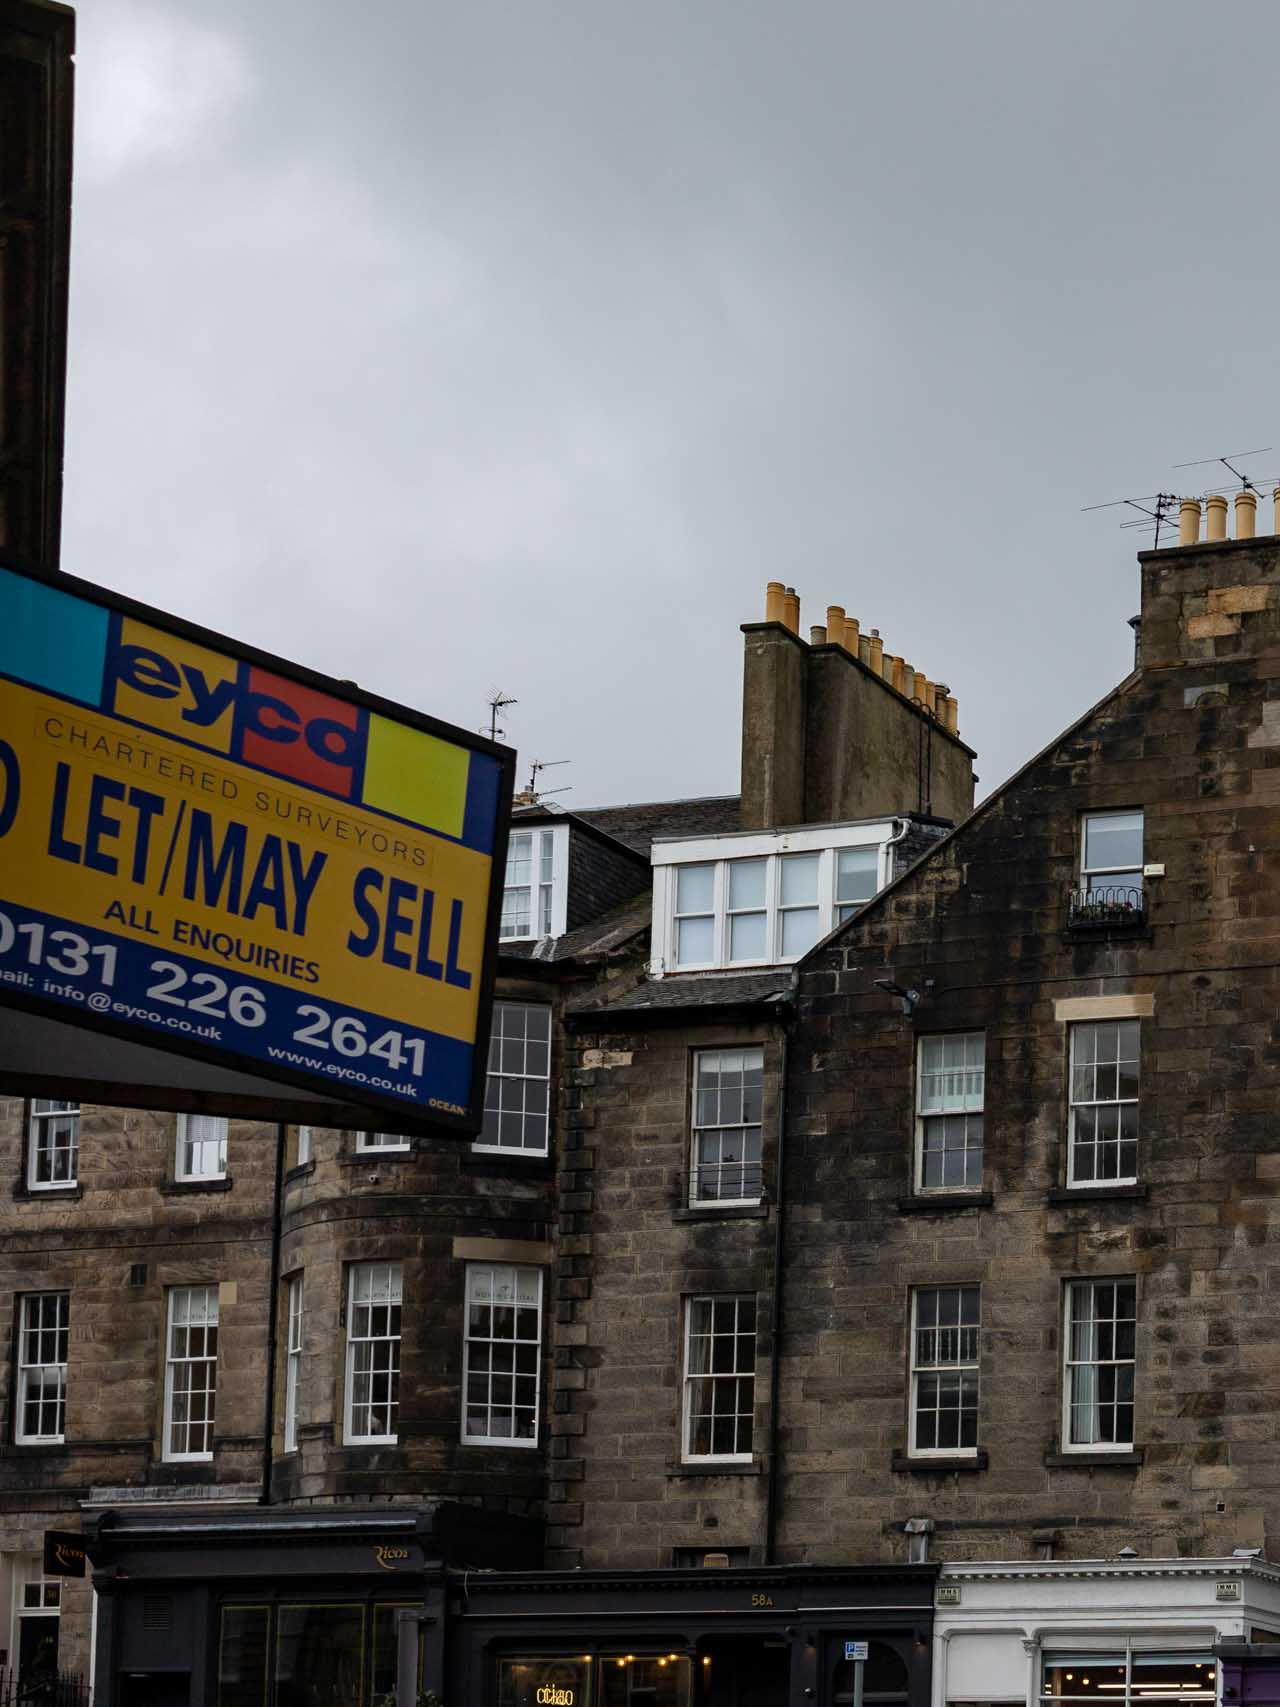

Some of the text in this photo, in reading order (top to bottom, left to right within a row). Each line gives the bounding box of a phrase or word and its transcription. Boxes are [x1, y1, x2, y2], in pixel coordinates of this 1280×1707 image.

[116, 643, 357, 768] eyco
[45, 717, 239, 800] CHARTERED
[255, 791, 427, 867] SURVEYORS
[103, 900, 320, 984] ALL ENQUIRIES
[347, 866, 473, 990] SELL
[146, 960, 267, 1028] 226
[293, 1004, 426, 1077] 2641
[266, 1046, 418, 1098] www.eyco.co.uk
[428, 1097, 466, 1117] OCEAN
